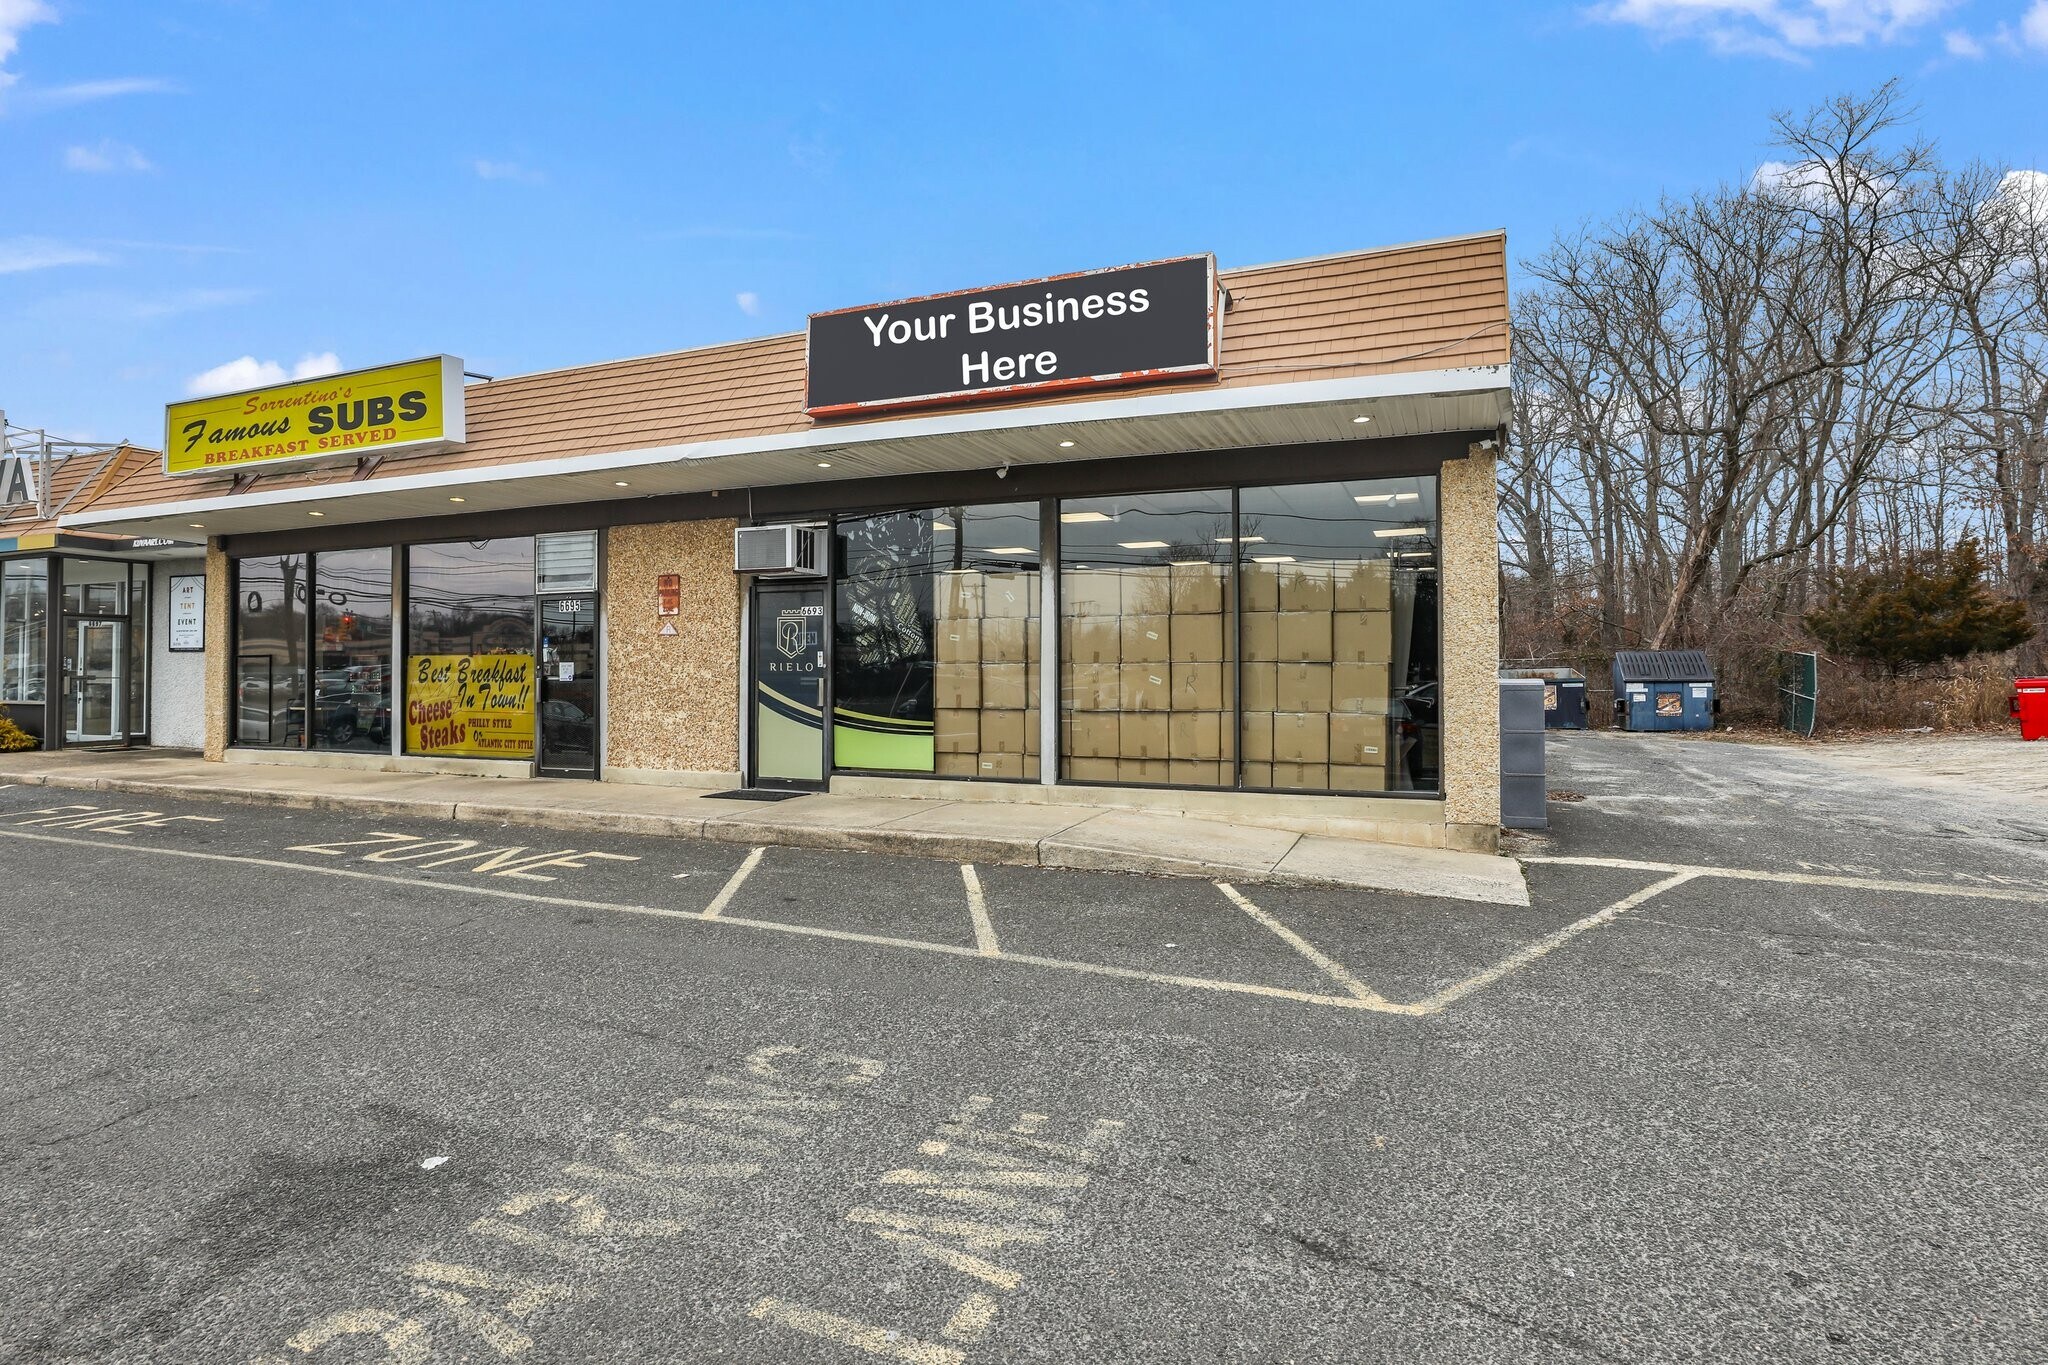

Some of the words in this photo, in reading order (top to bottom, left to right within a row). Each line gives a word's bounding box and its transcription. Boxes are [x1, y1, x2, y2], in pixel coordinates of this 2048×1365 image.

[864, 311, 956, 347] Your
[968, 288, 1149, 335] Business
[962, 350, 1058, 386] Here
[243, 386, 353, 415] Sorrentino's
[183, 416, 291, 453] Famous
[308, 391, 427, 435] SUBS
[204, 440, 309, 465] BREAKFAST
[319, 428, 397, 449] SERVED
[560, 600, 580, 611] 6695
[801, 606, 823, 615] 6693
[418, 658, 451, 683] Best
[458, 658, 527, 691] Breakfast
[770, 662, 814, 672] RIELO
[458, 683, 475, 708] In
[479, 683, 530, 711] Town!!
[1185, 674, 1197, 693] R
[408, 699, 452, 726] Cheese
[468, 718, 490, 728] PHILLY
[493, 719, 512, 728] STYLE
[420, 719, 466, 751] Steaks
[473, 730, 482, 741] Or
[478, 739, 503, 748] ATLANTIC
[504, 739, 516, 749] CITY
[518, 740, 533, 750] STYLE
[0, 805, 224, 835] FIRE
[285, 832, 642, 881] ZONE
[747, 1095, 1126, 1365] LANE
